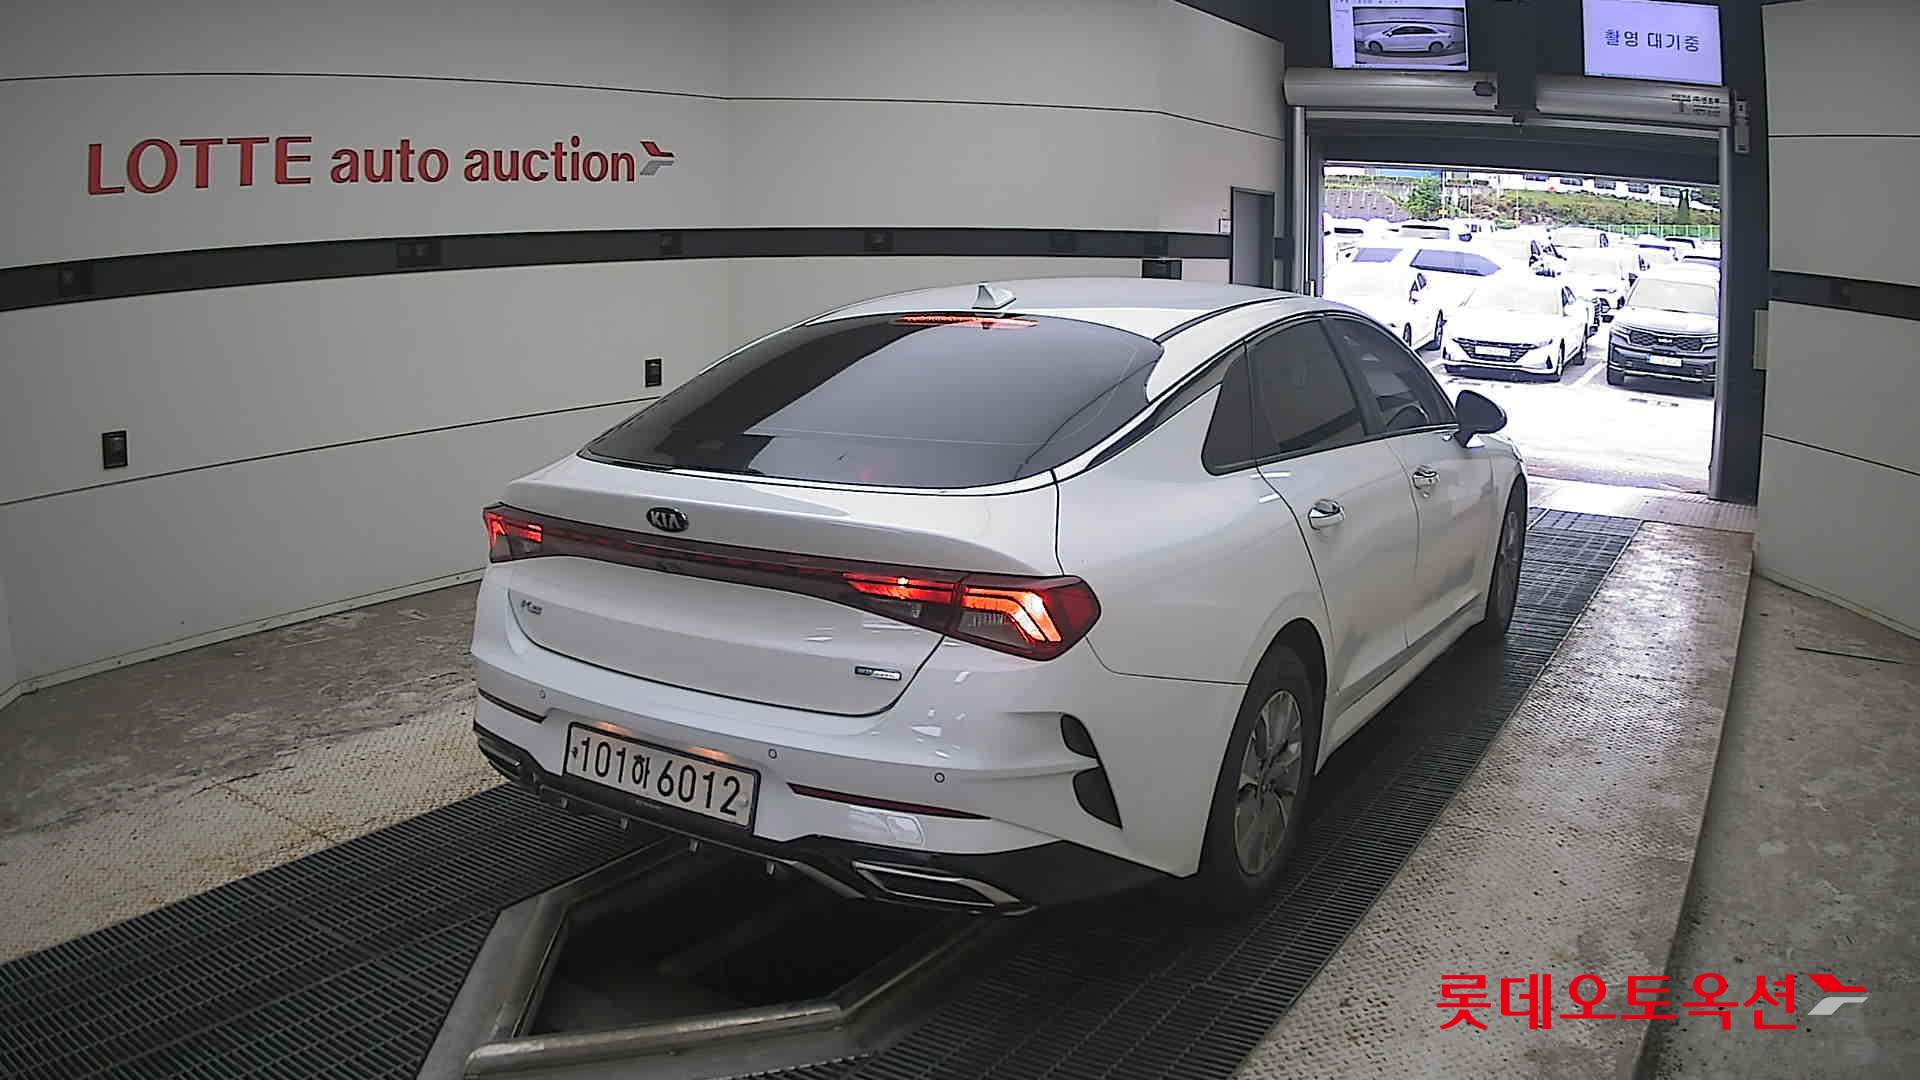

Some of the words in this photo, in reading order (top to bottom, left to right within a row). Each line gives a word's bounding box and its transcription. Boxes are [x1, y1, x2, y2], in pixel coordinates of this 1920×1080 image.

[1646, 32, 1700, 52] 대기중
[87, 136, 312, 195] LOTTE
[330, 138, 449, 183] auto
[463, 135, 636, 184] auction
[650, 510, 682, 529] KIA
